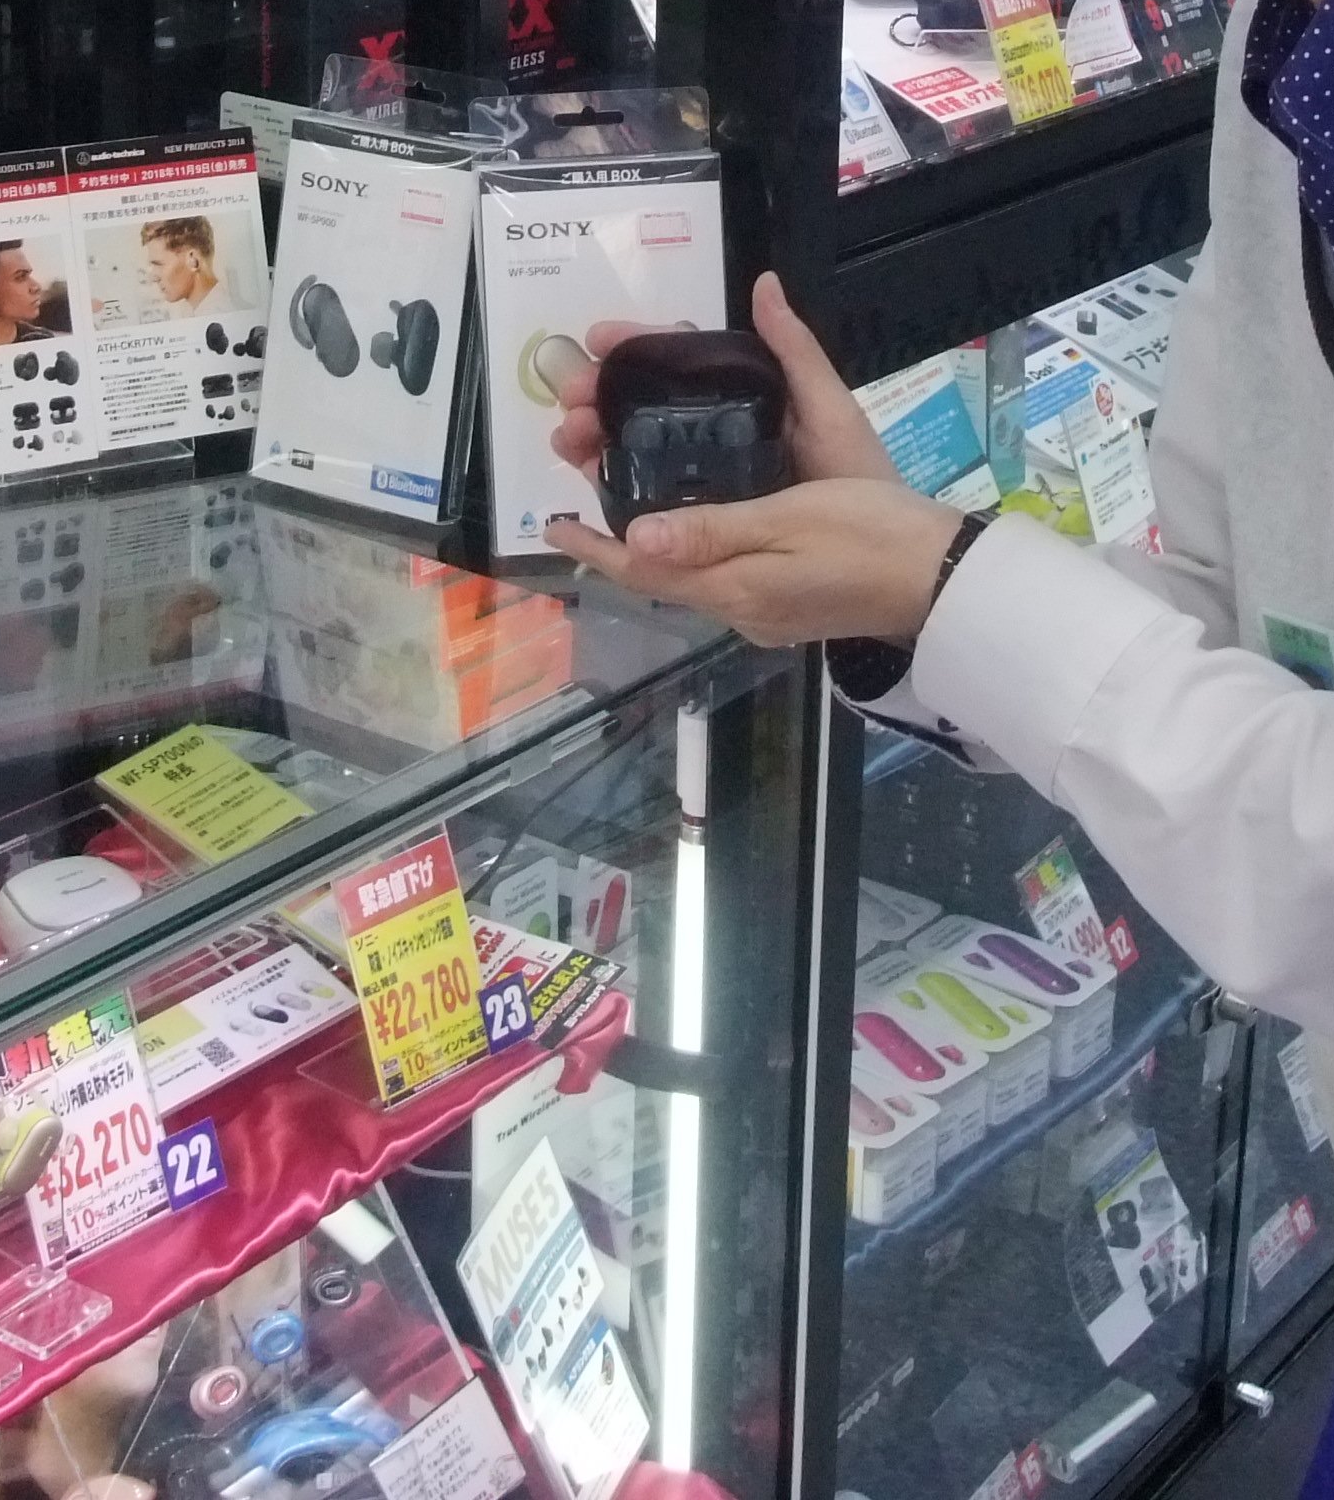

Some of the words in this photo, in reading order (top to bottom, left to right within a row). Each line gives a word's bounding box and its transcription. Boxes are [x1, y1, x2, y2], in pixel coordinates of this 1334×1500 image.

[366, 100, 405, 121] WIREL
[164, 144, 183, 154] NEW
[390, 141, 415, 158] BOX
[36, 160, 56, 170] 2018
[78, 173, 130, 188] 予約受付中
[141, 158, 248, 181] 2018年11月9日(金)発売
[611, 167, 642, 183] BOX
[300, 172, 368, 198] SONY
[296, 212, 338, 229] WF-SP900
[505, 219, 593, 242] SONY
[508, 265, 561, 278] WF-SP900
[97, 336, 165, 354] ATH-CKR7TW
[387, 473, 435, 499] Bluetooth
[164, 761, 197, 783] 特長
[357, 853, 436, 919] 緊急値下げ
[1108, 924, 1131, 960] 12
[369, 956, 472, 1046] ¥22,780
[485, 984, 529, 1042] 23
[39, 1102, 152, 1208] ¥32,270
[166, 1132, 217, 1197] 22
